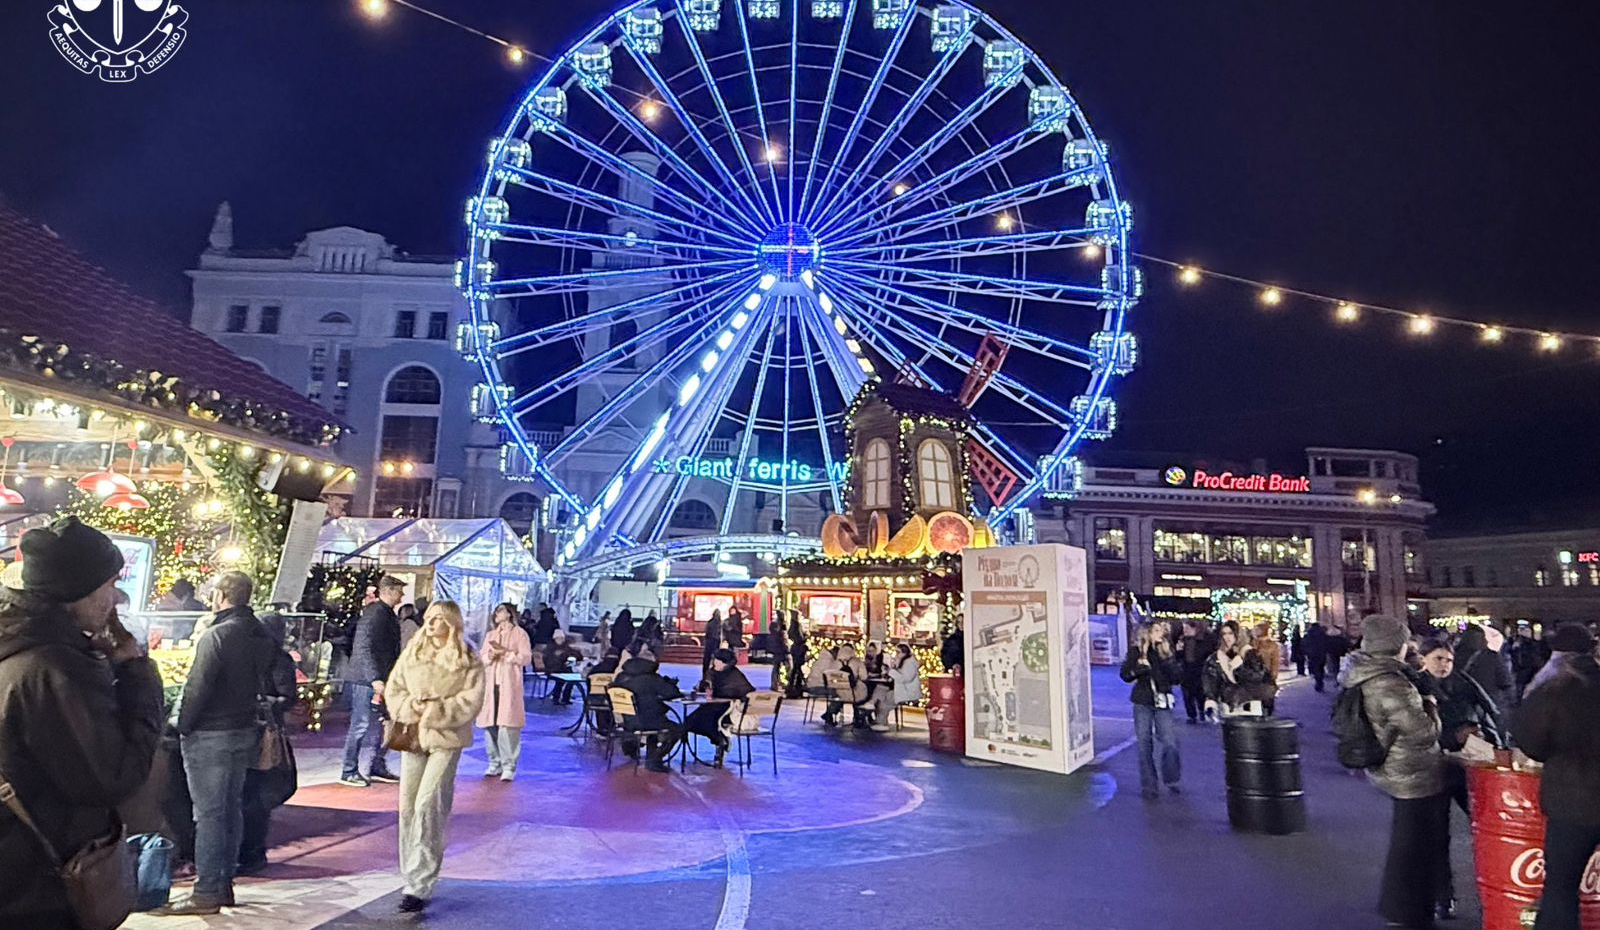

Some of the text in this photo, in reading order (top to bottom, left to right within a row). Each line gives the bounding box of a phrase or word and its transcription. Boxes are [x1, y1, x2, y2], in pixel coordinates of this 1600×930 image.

[675, 455, 733, 478] Giant
[749, 457, 812, 480] ferris
[1193, 470, 1310, 492] ProCredit Bank
